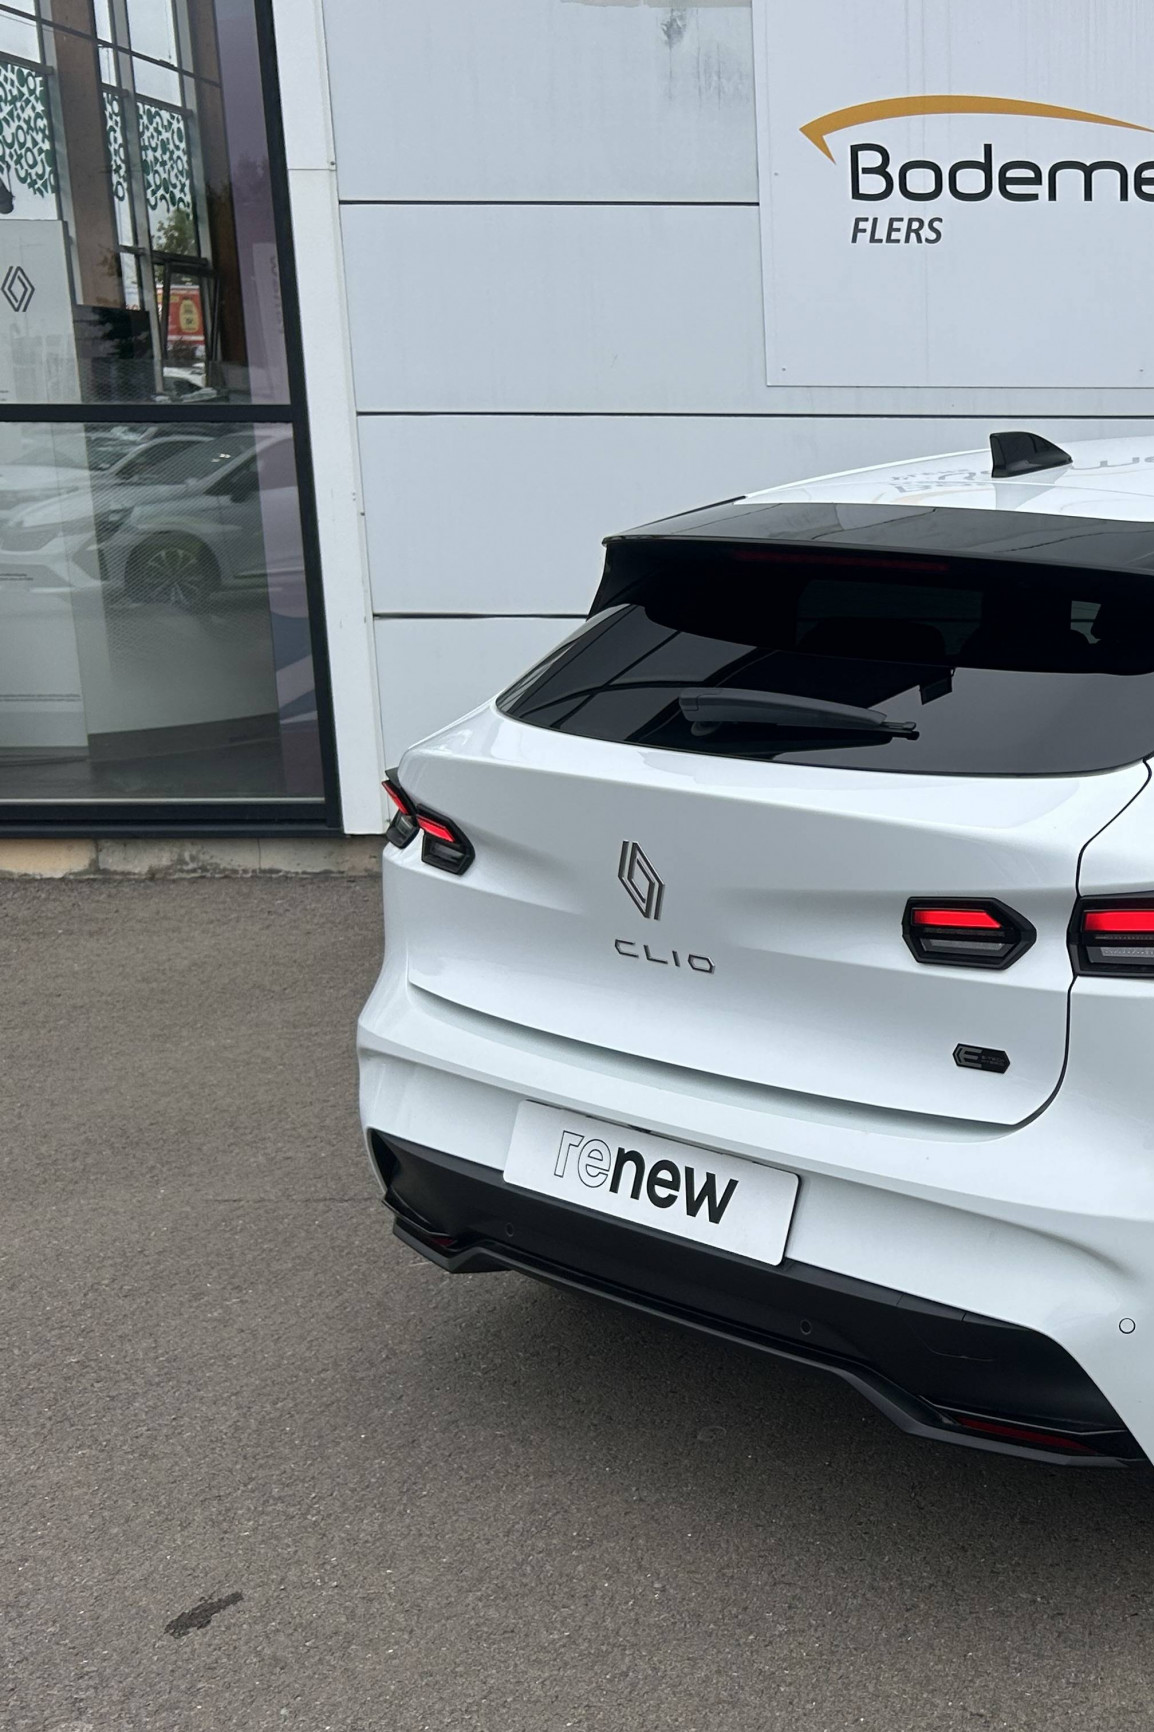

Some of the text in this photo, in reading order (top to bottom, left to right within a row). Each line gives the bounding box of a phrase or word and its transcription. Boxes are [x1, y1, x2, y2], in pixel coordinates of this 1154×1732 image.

[851, 217, 943, 244] FLERS
[614, 938, 716, 975] CLIO
[553, 1129, 740, 1225] renew
